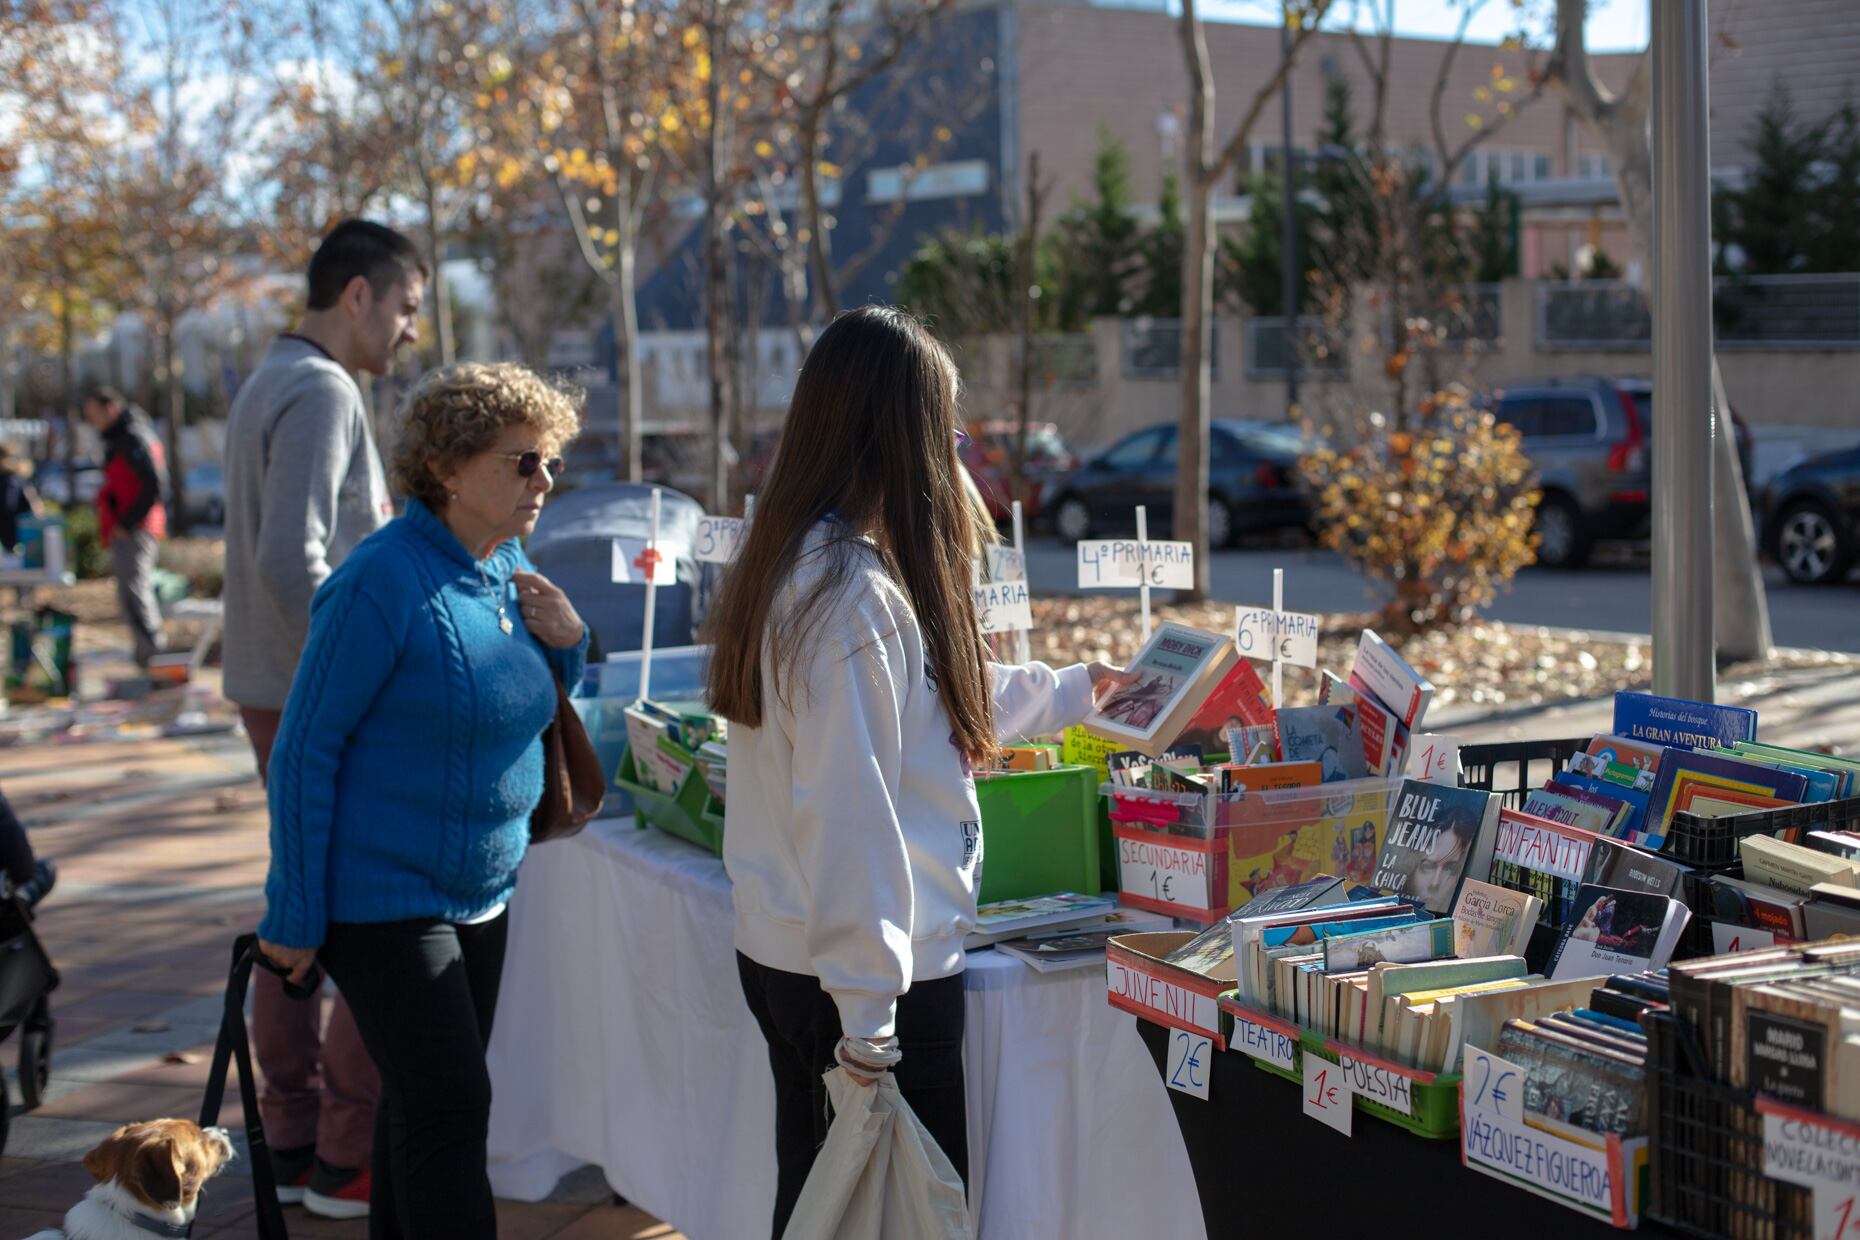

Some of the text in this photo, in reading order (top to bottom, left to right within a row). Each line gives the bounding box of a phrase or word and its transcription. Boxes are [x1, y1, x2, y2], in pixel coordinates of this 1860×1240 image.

[1112, 542, 1190, 563] PRIMARIA
[1260, 610, 1317, 641] PRIMARIA
[1632, 724, 1723, 749] LA GRAN AVENTURA
[1398, 793, 1441, 822] BLUE
[1388, 821, 1441, 856] JEANS
[1121, 839, 1207, 878] SECUNDARIA
[1382, 853, 1397, 869] LA
[1374, 870, 1407, 891] CHICA
[1493, 900, 1516, 917] Lorca
[1236, 1018, 1294, 1061] TEATRO
[1170, 1032, 1208, 1088] 2€
[1308, 1070, 1339, 1109] 1€
